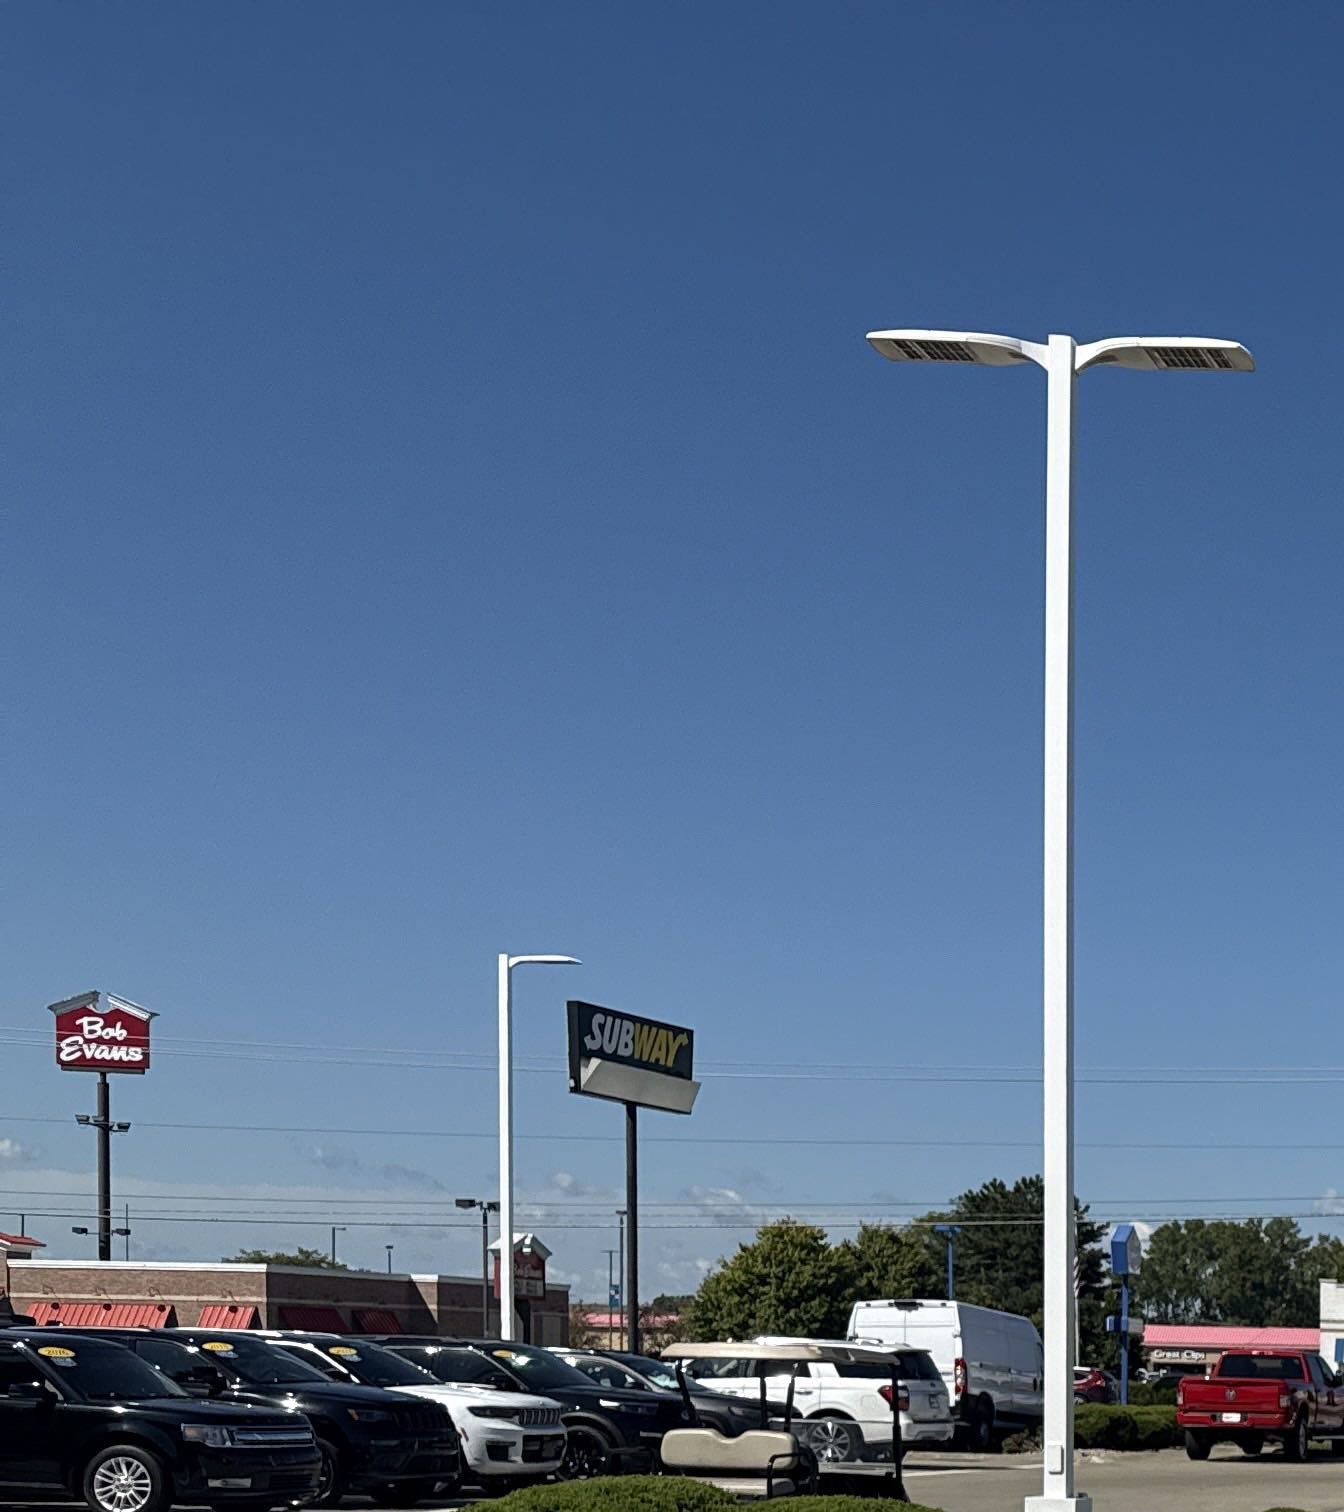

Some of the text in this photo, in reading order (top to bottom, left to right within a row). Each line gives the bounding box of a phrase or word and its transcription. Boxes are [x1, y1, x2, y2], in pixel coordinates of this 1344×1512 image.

[75, 1016, 127, 1041] Bob
[584, 1012, 689, 1068] SUBWAY
[60, 1036, 143, 1061] Evans
[1154, 1349, 1180, 1359] Great
